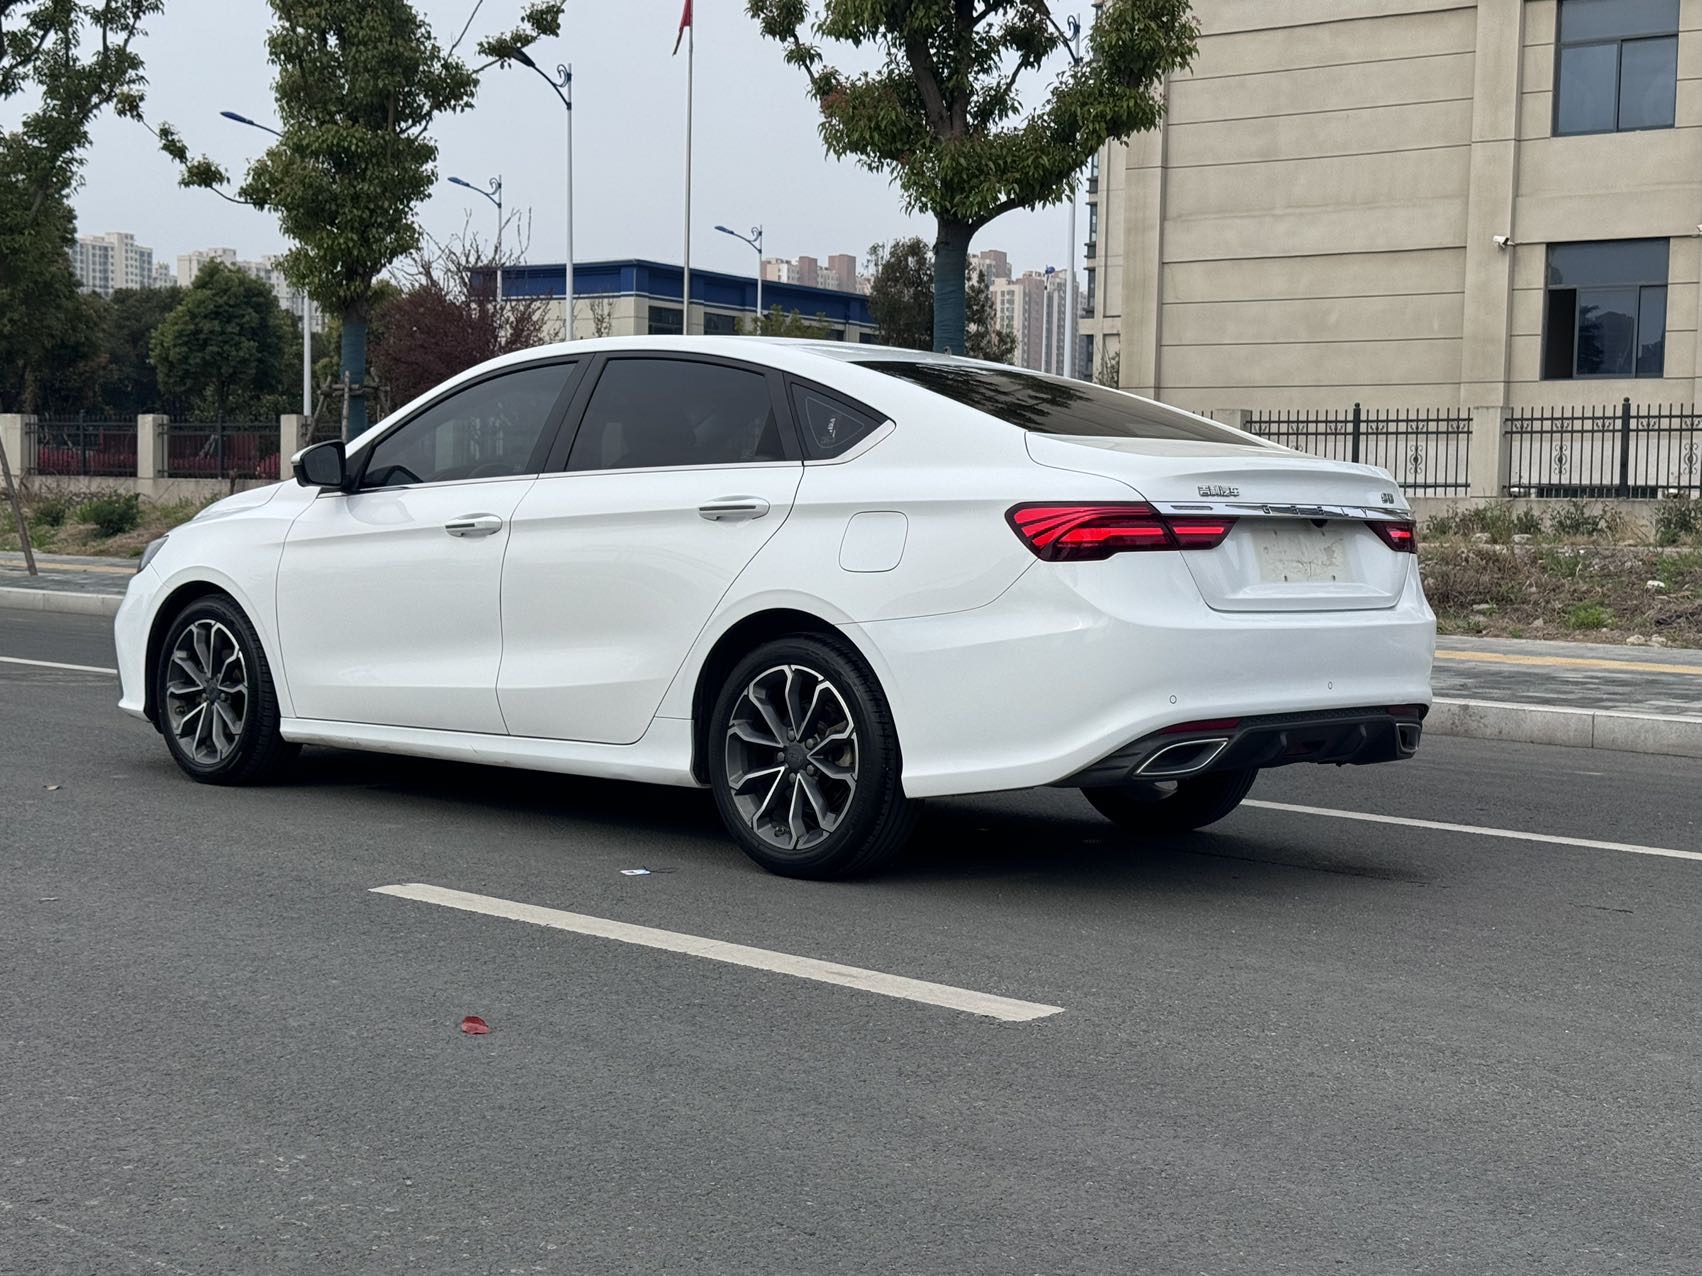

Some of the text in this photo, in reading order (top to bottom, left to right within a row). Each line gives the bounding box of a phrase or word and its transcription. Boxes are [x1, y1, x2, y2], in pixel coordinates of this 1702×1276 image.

[1198, 485, 1240, 498] 吉利汽车
[1261, 504, 1368, 518] GEELY
